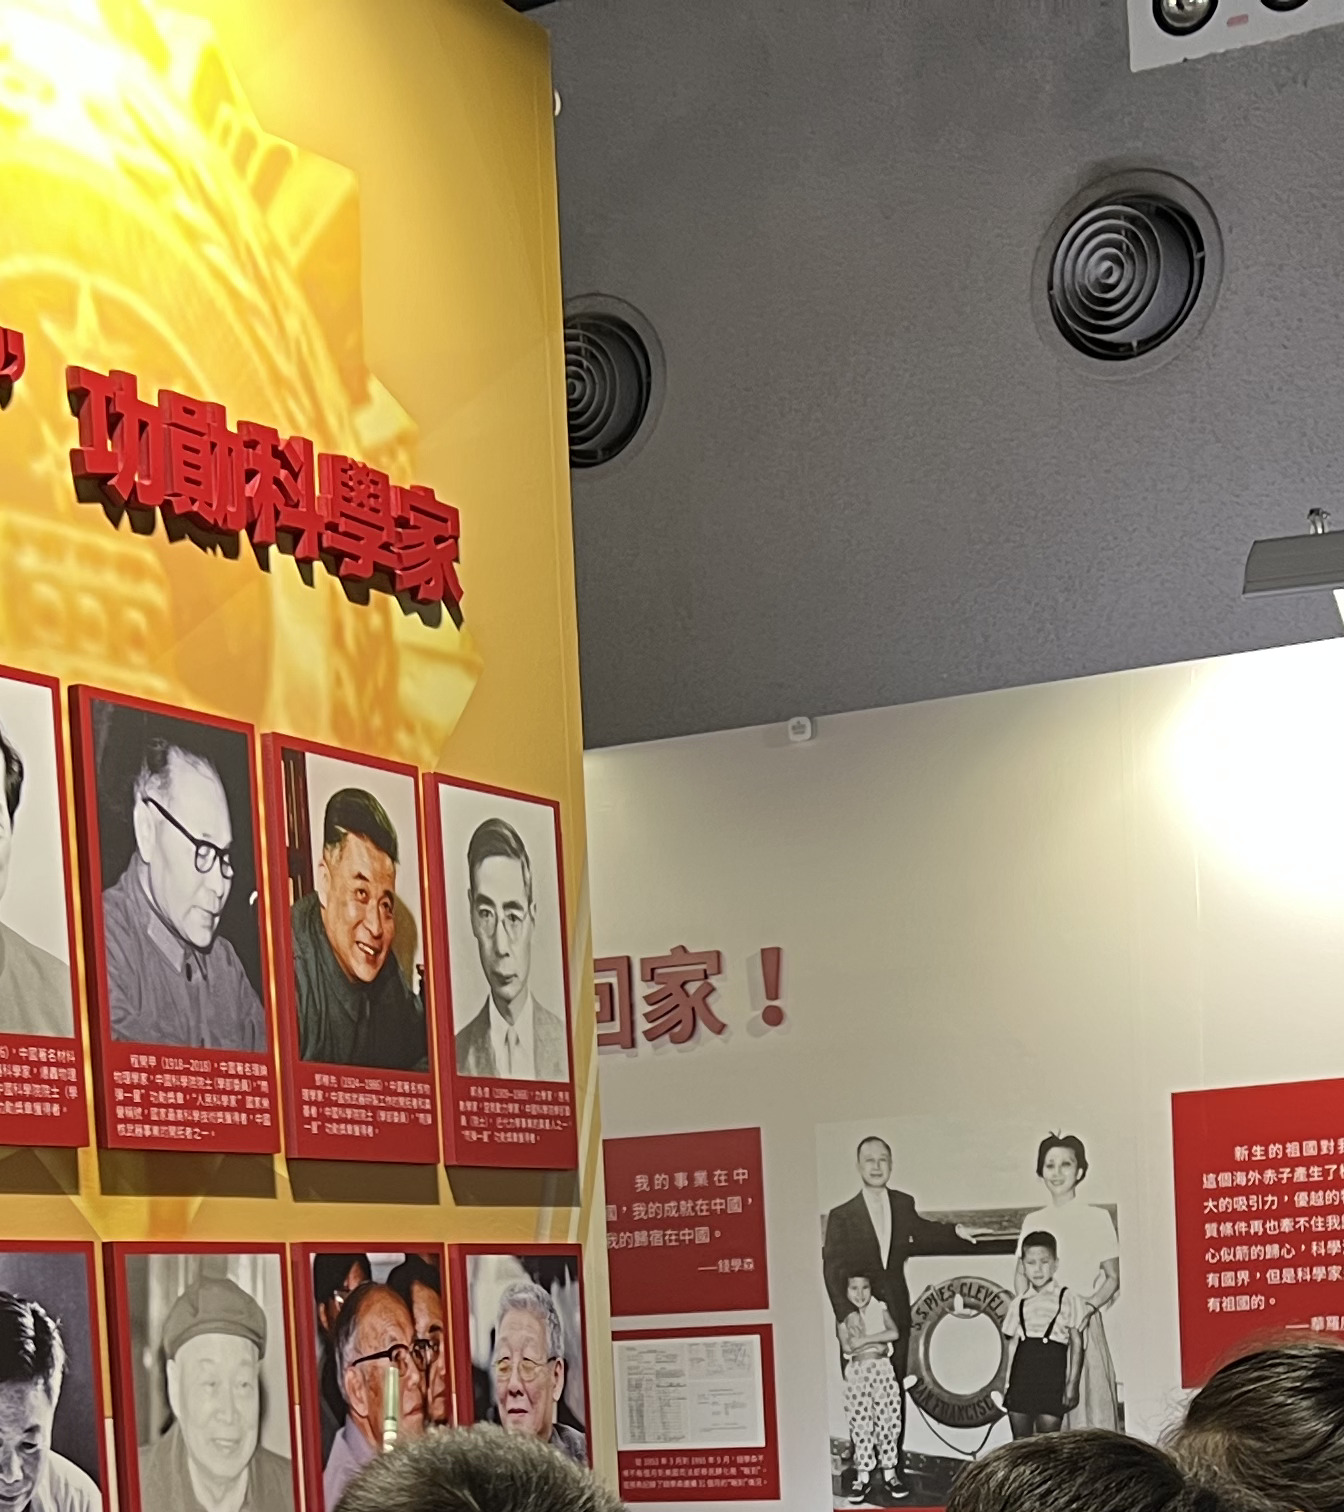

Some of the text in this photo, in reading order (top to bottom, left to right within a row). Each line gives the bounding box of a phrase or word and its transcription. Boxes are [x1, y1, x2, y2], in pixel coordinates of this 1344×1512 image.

[66, 366, 464, 604] 功勳科學家
